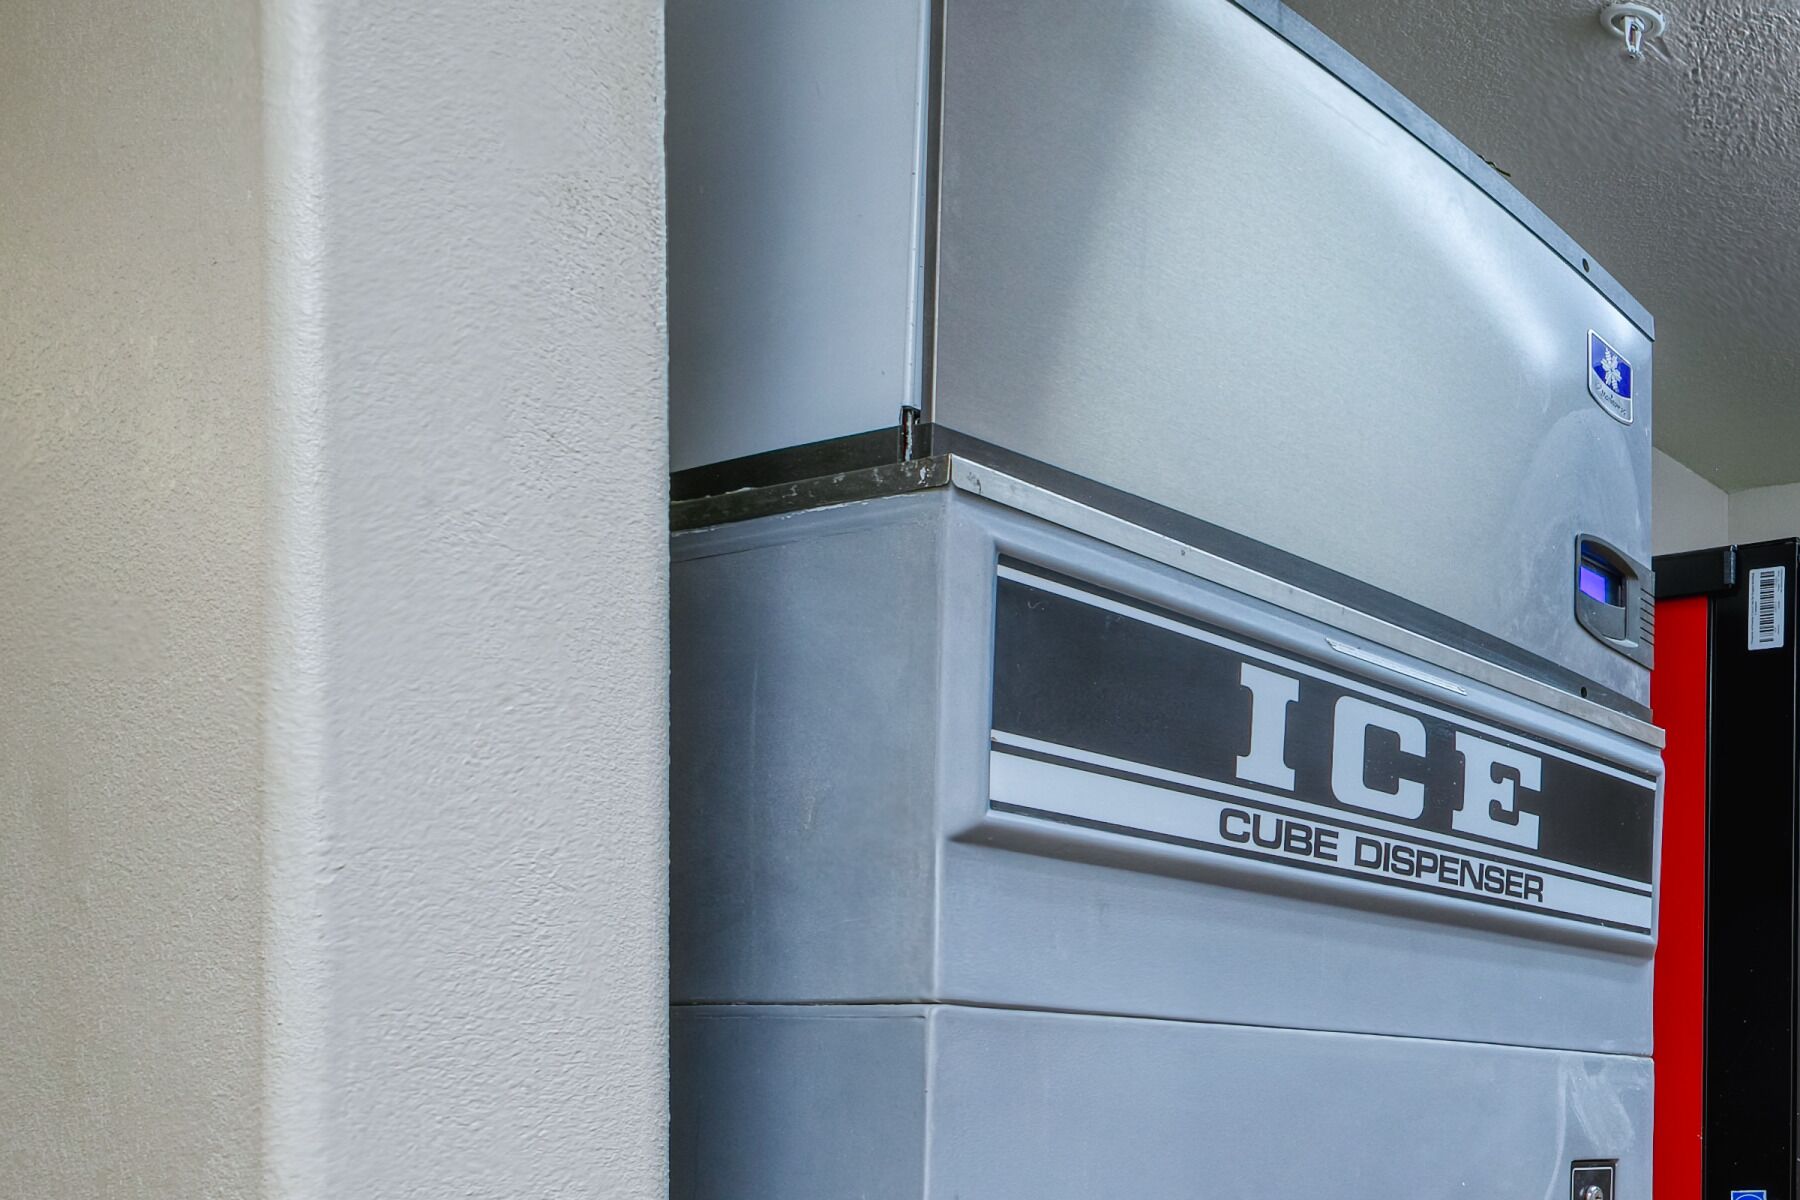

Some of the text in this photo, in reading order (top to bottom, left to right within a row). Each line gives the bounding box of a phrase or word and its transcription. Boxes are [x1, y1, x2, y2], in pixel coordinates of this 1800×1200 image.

[1236, 661, 1542, 850] ICE
[1219, 808, 1544, 903] CUBE DISPENSER
